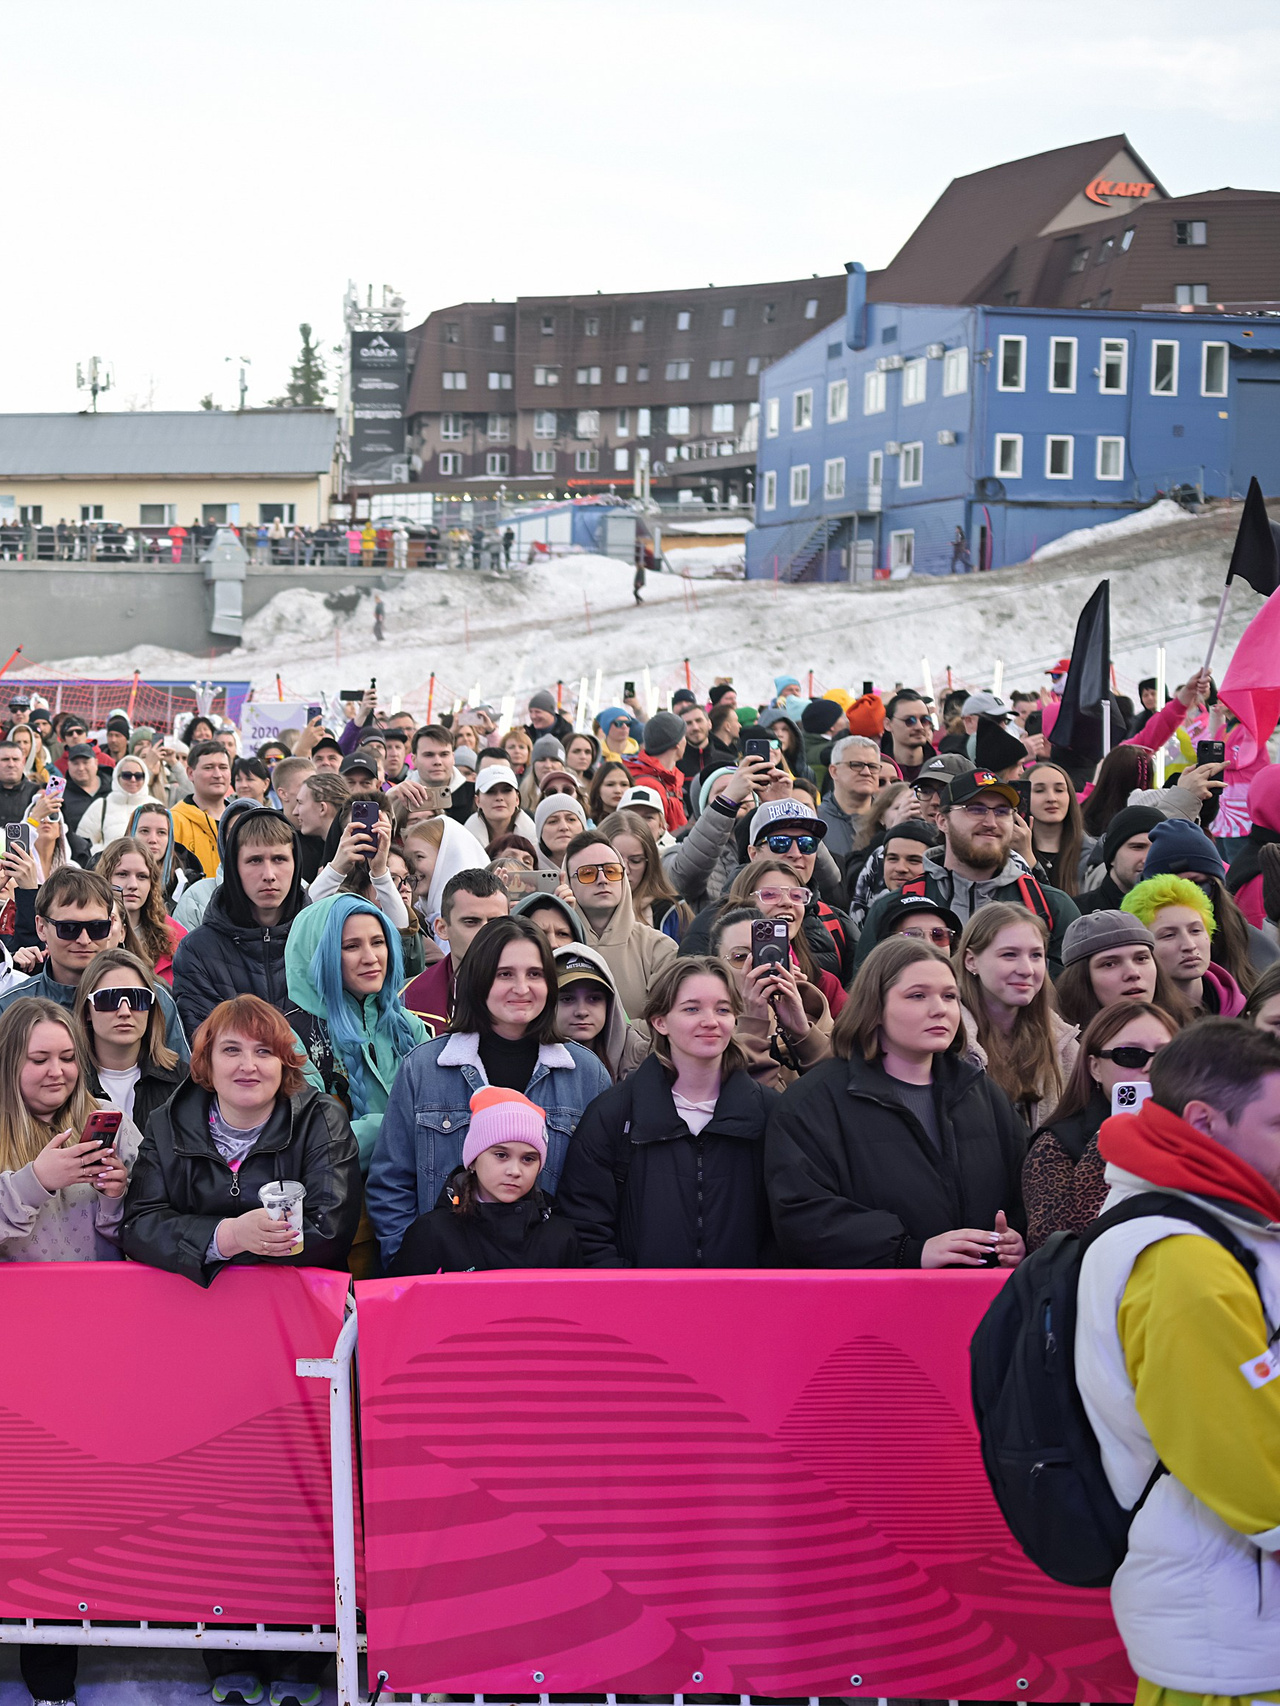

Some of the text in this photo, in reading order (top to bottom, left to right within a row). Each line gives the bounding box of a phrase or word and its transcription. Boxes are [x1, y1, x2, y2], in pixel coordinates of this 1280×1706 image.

[1096, 180, 1155, 198] КАНТ
[360, 347, 398, 357] ОЛЬГА
[251, 727, 279, 739] 2020
